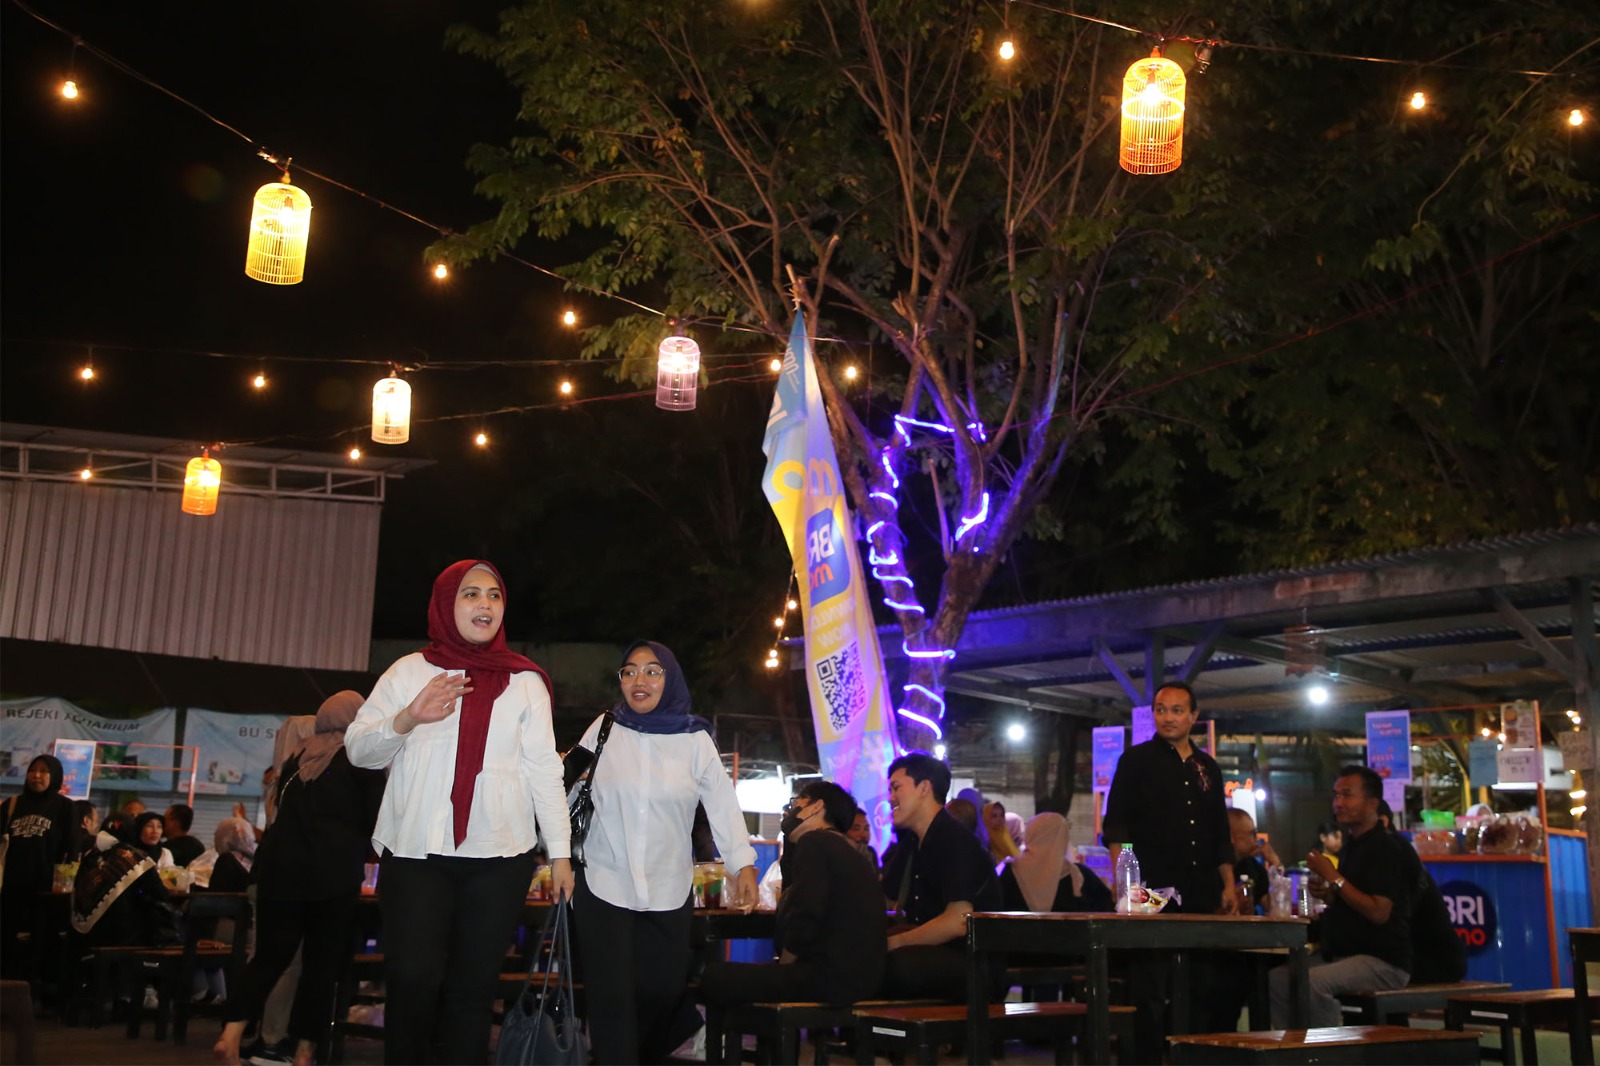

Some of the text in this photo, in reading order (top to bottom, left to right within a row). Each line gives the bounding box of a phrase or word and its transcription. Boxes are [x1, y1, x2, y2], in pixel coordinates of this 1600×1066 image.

[6, 707, 59, 720] REJEKI
[239, 726, 260, 738] BU
[1442, 895, 1485, 925] BRI
